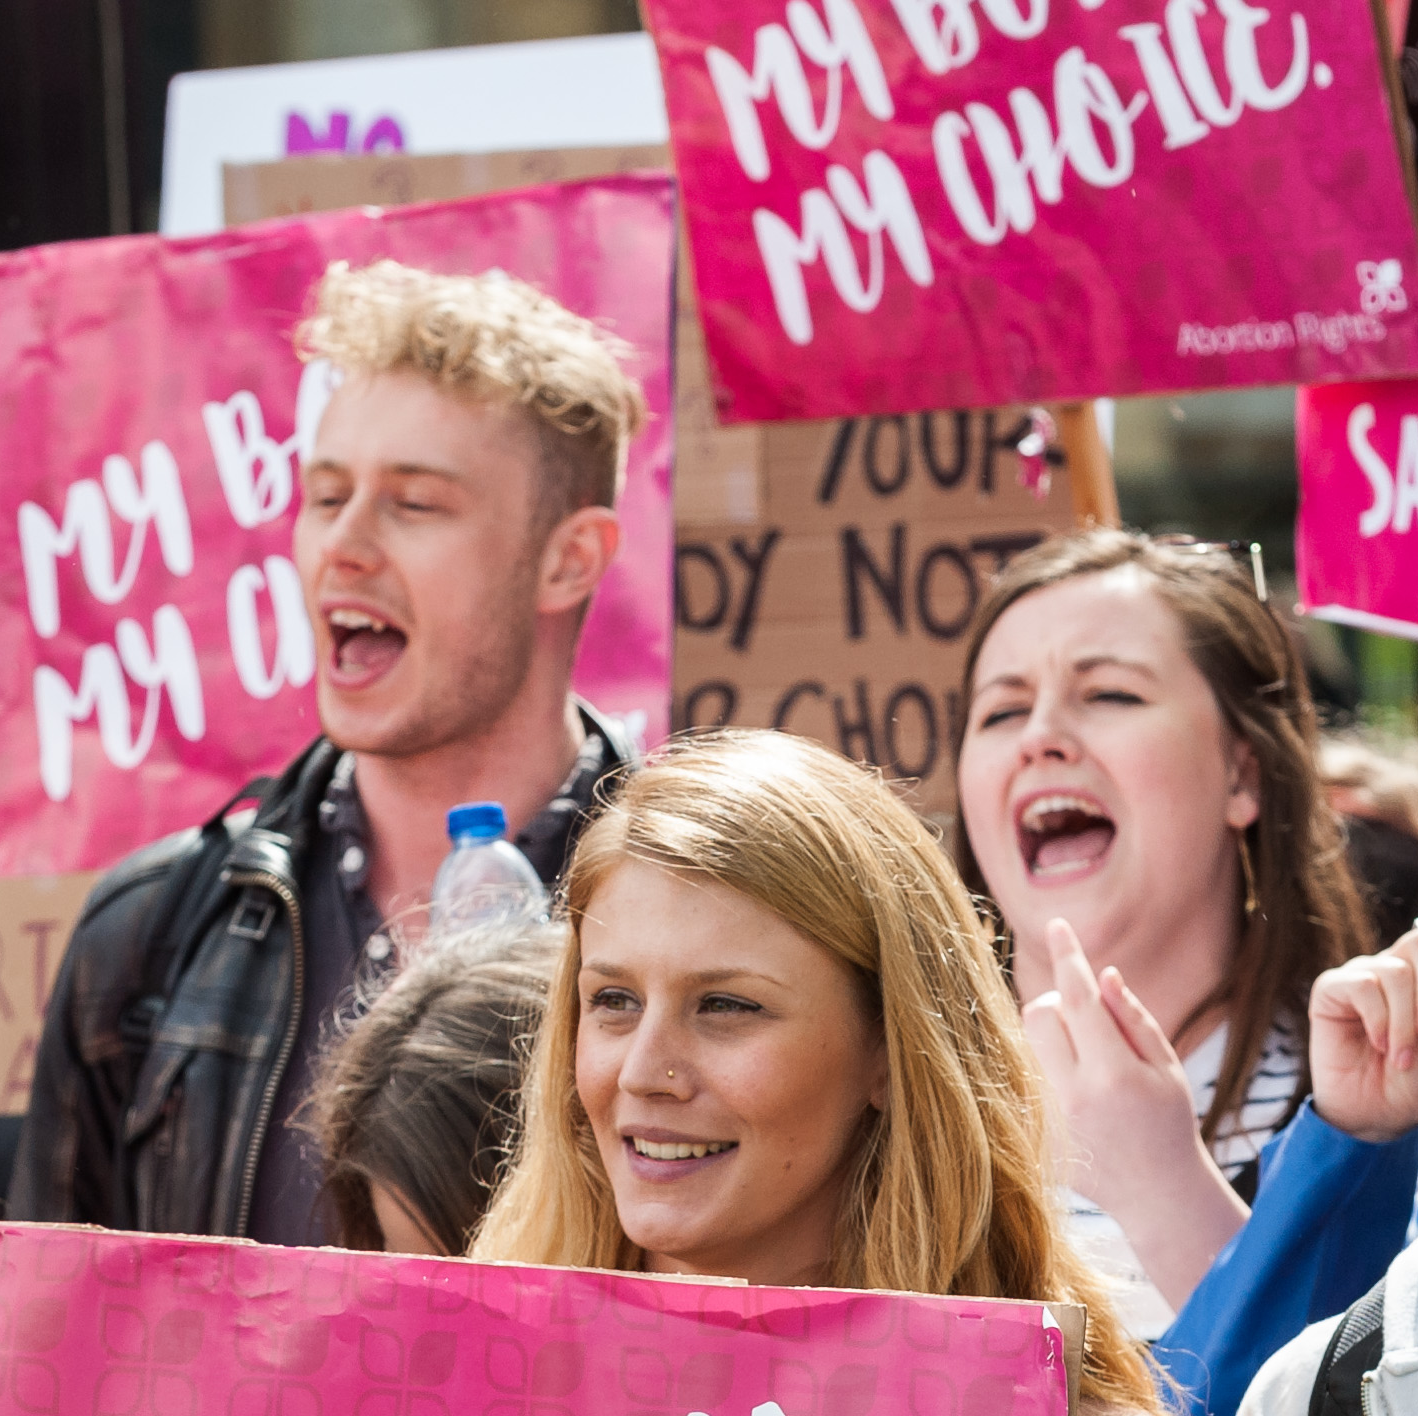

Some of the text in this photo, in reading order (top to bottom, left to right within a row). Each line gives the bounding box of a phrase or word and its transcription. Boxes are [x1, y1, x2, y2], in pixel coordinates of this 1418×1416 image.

[704, 0, 895, 183] MY
[752, 149, 936, 346] MY
[17, 438, 194, 639] MY
[32, 604, 207, 801] MY
